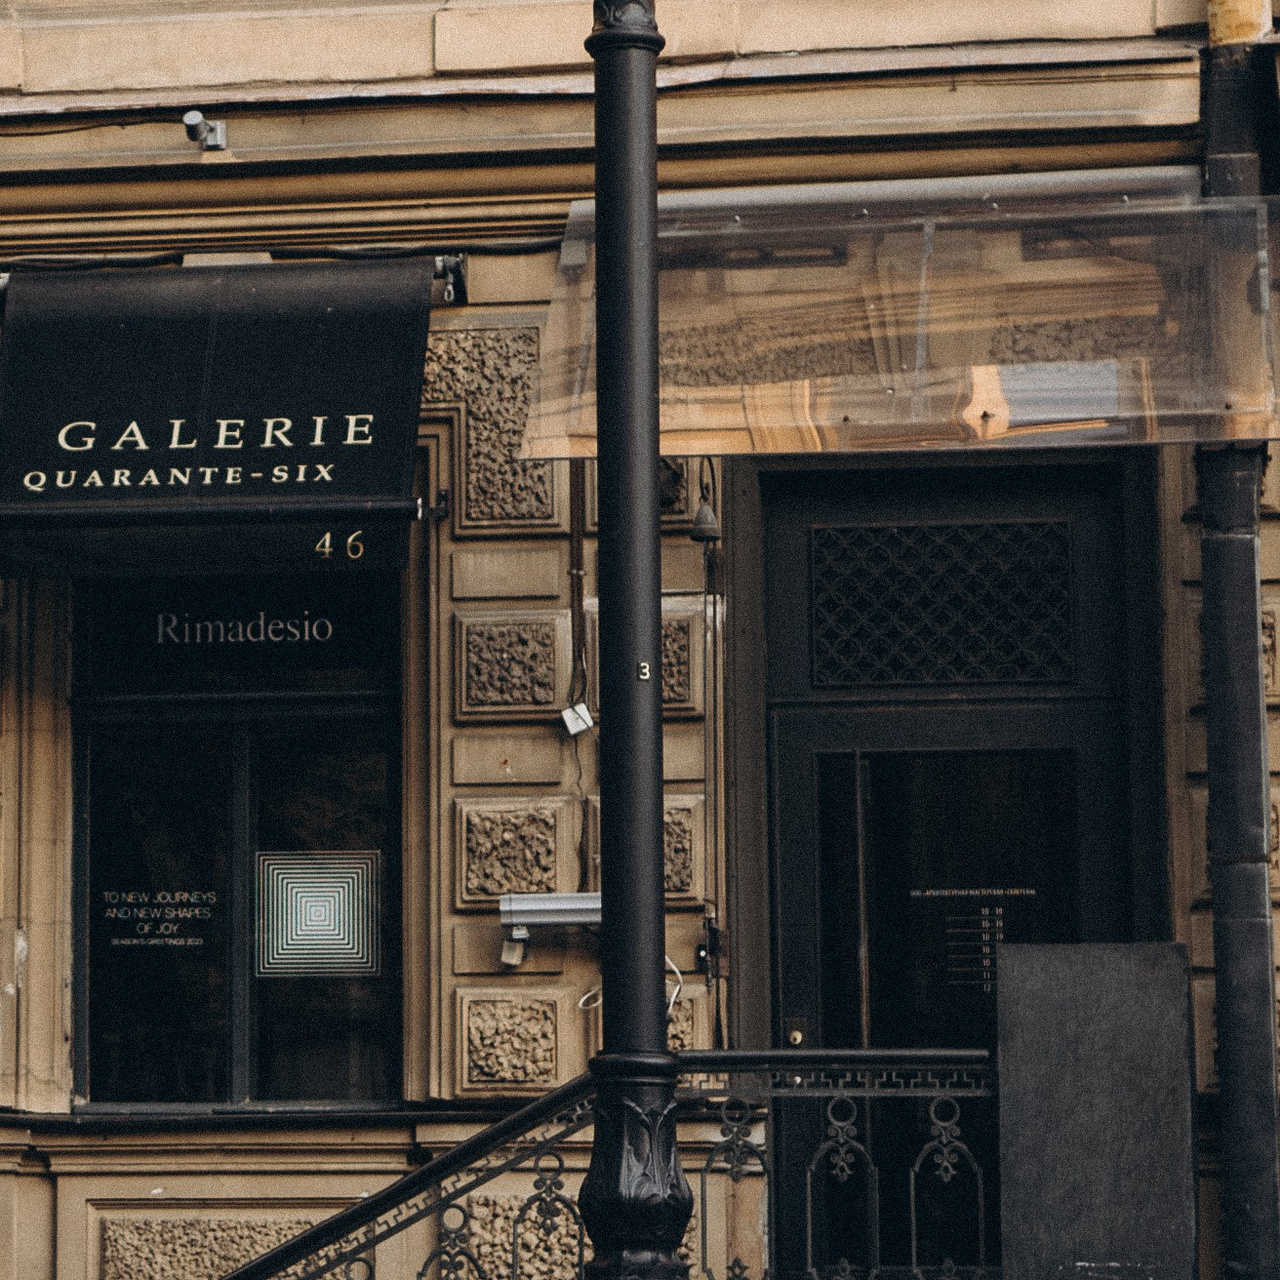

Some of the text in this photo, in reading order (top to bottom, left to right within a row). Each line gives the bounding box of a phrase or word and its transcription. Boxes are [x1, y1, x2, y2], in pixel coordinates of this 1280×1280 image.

[57, 414, 374, 451] GALERIE
[23, 463, 334, 492] QUARANTE-SIX
[314, 530, 364, 559] 46
[157, 610, 333, 644] Rimadesio
[638, 661, 651, 680] 3
[102, 890, 218, 904] TO NEW JOURNEYS
[105, 906, 212, 920] AND NEW SHAPES
[136, 921, 181, 935] OF JOY
